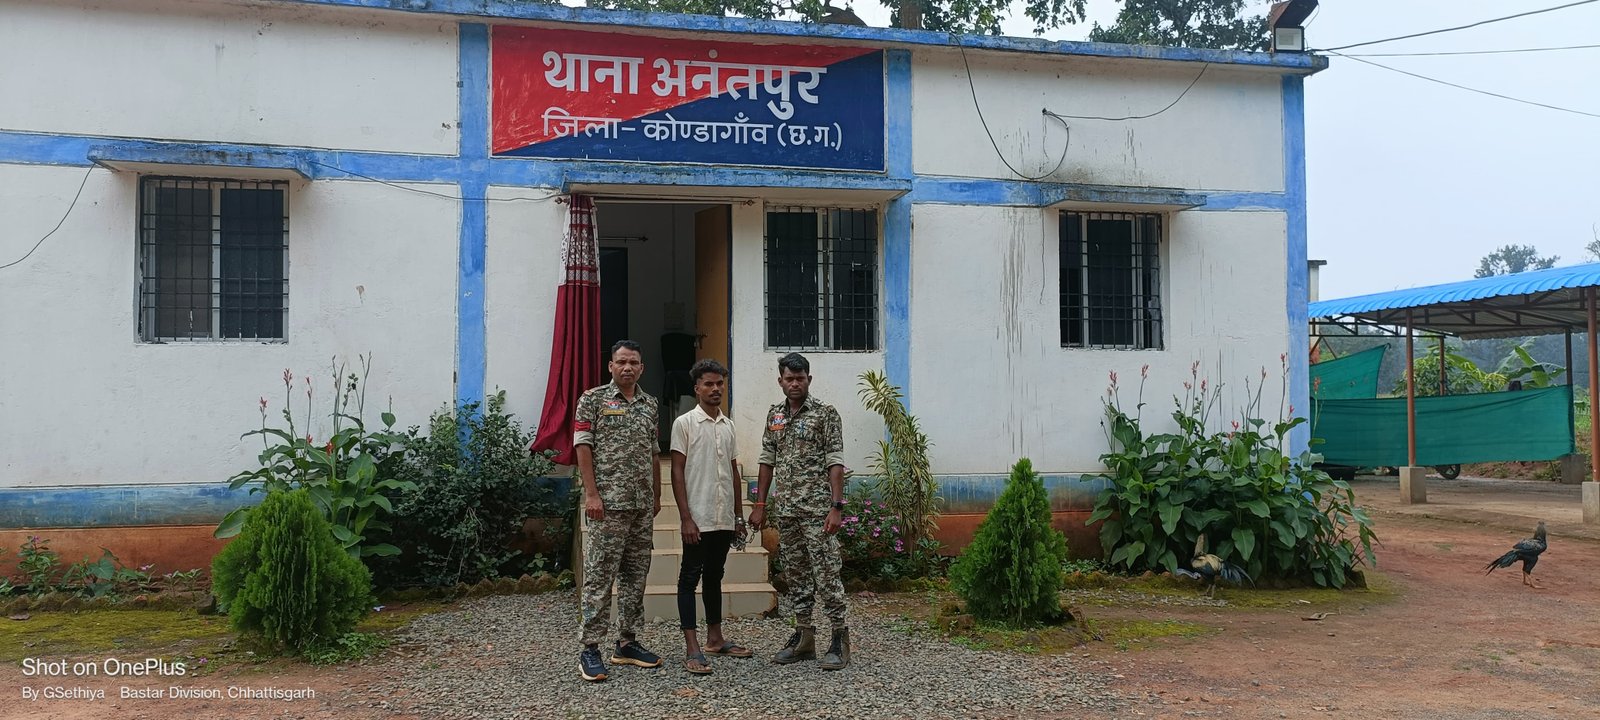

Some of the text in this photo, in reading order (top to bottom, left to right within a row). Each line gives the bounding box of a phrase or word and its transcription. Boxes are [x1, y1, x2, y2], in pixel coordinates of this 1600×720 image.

[543, 49, 828, 120] थाना अनंतपुर
[641, 112, 774, 144] कोण्डागाँव
[777, 122, 843, 151] (छ.ग.)
